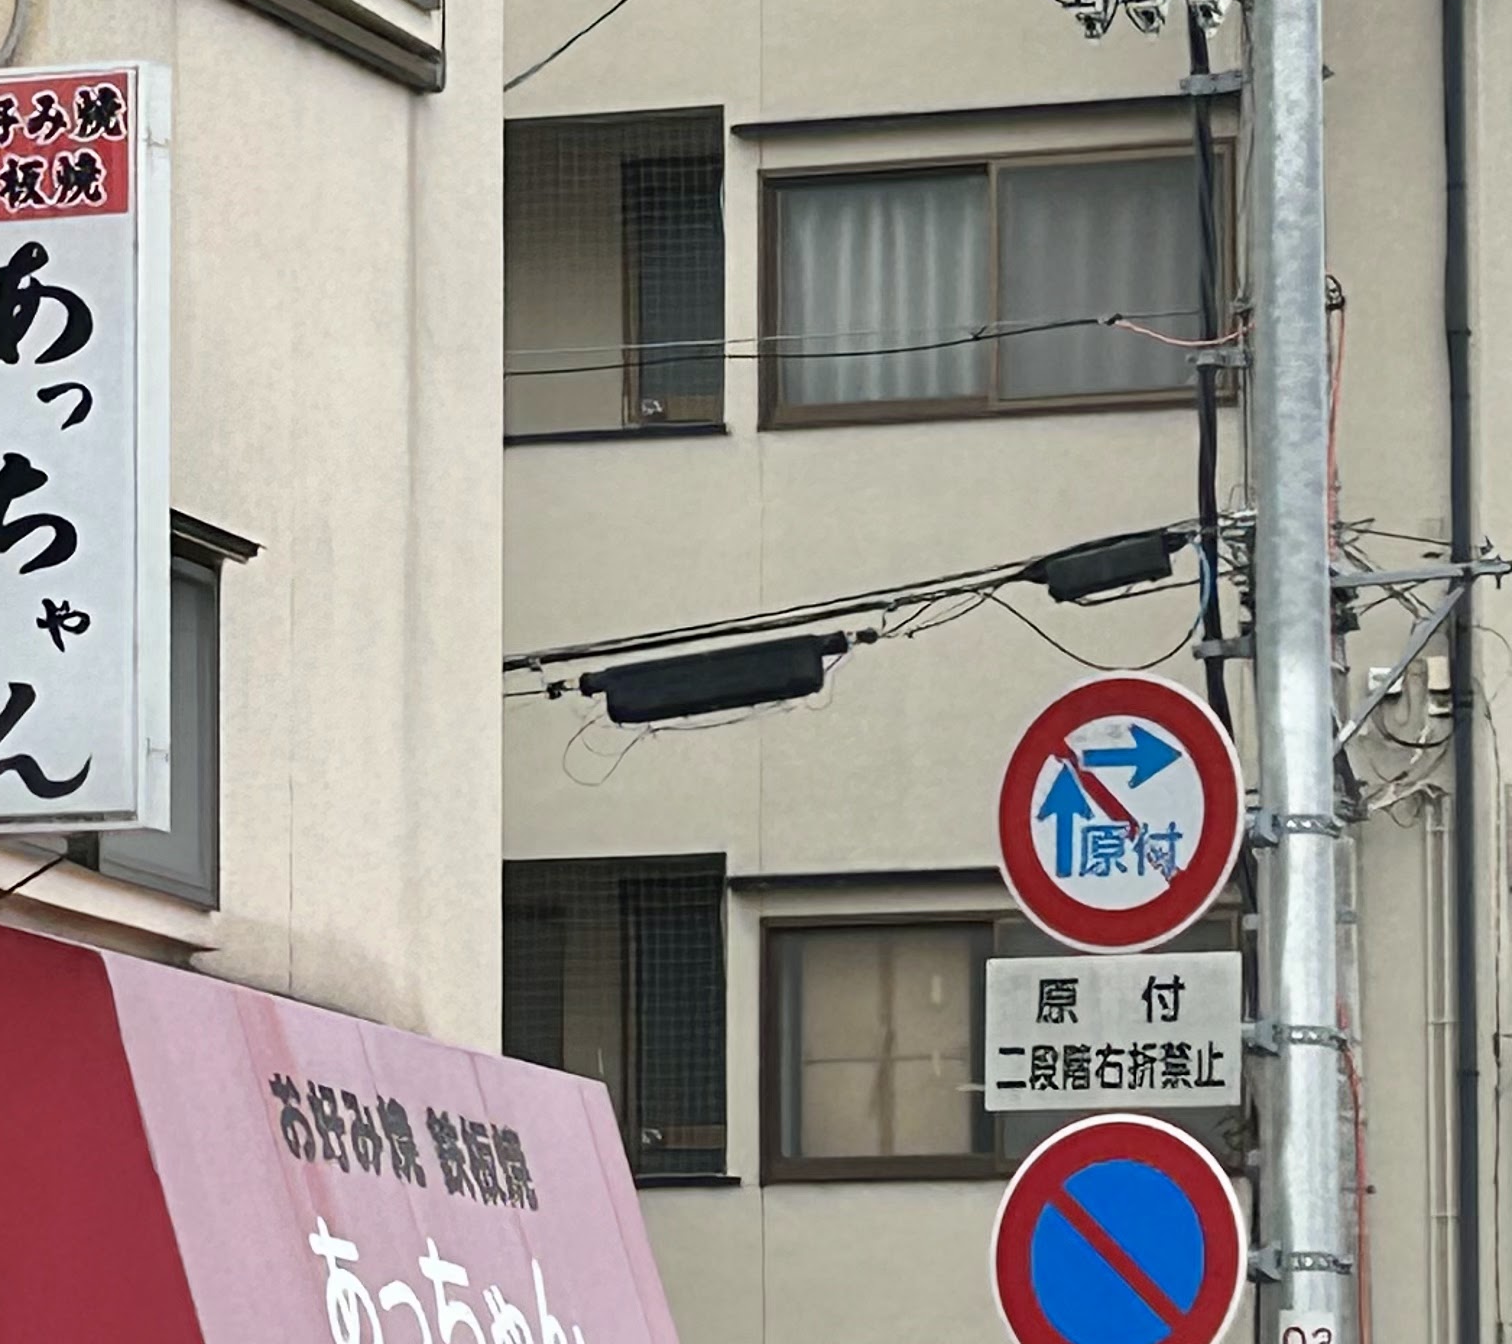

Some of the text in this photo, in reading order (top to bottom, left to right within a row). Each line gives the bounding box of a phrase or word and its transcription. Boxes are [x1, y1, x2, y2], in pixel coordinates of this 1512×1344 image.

[1079, 821, 1183, 882] 原付
[996, 1041, 1226, 1091] 二段階右折禁止
[269, 1072, 538, 1212] お好み焼 鉄板焼
